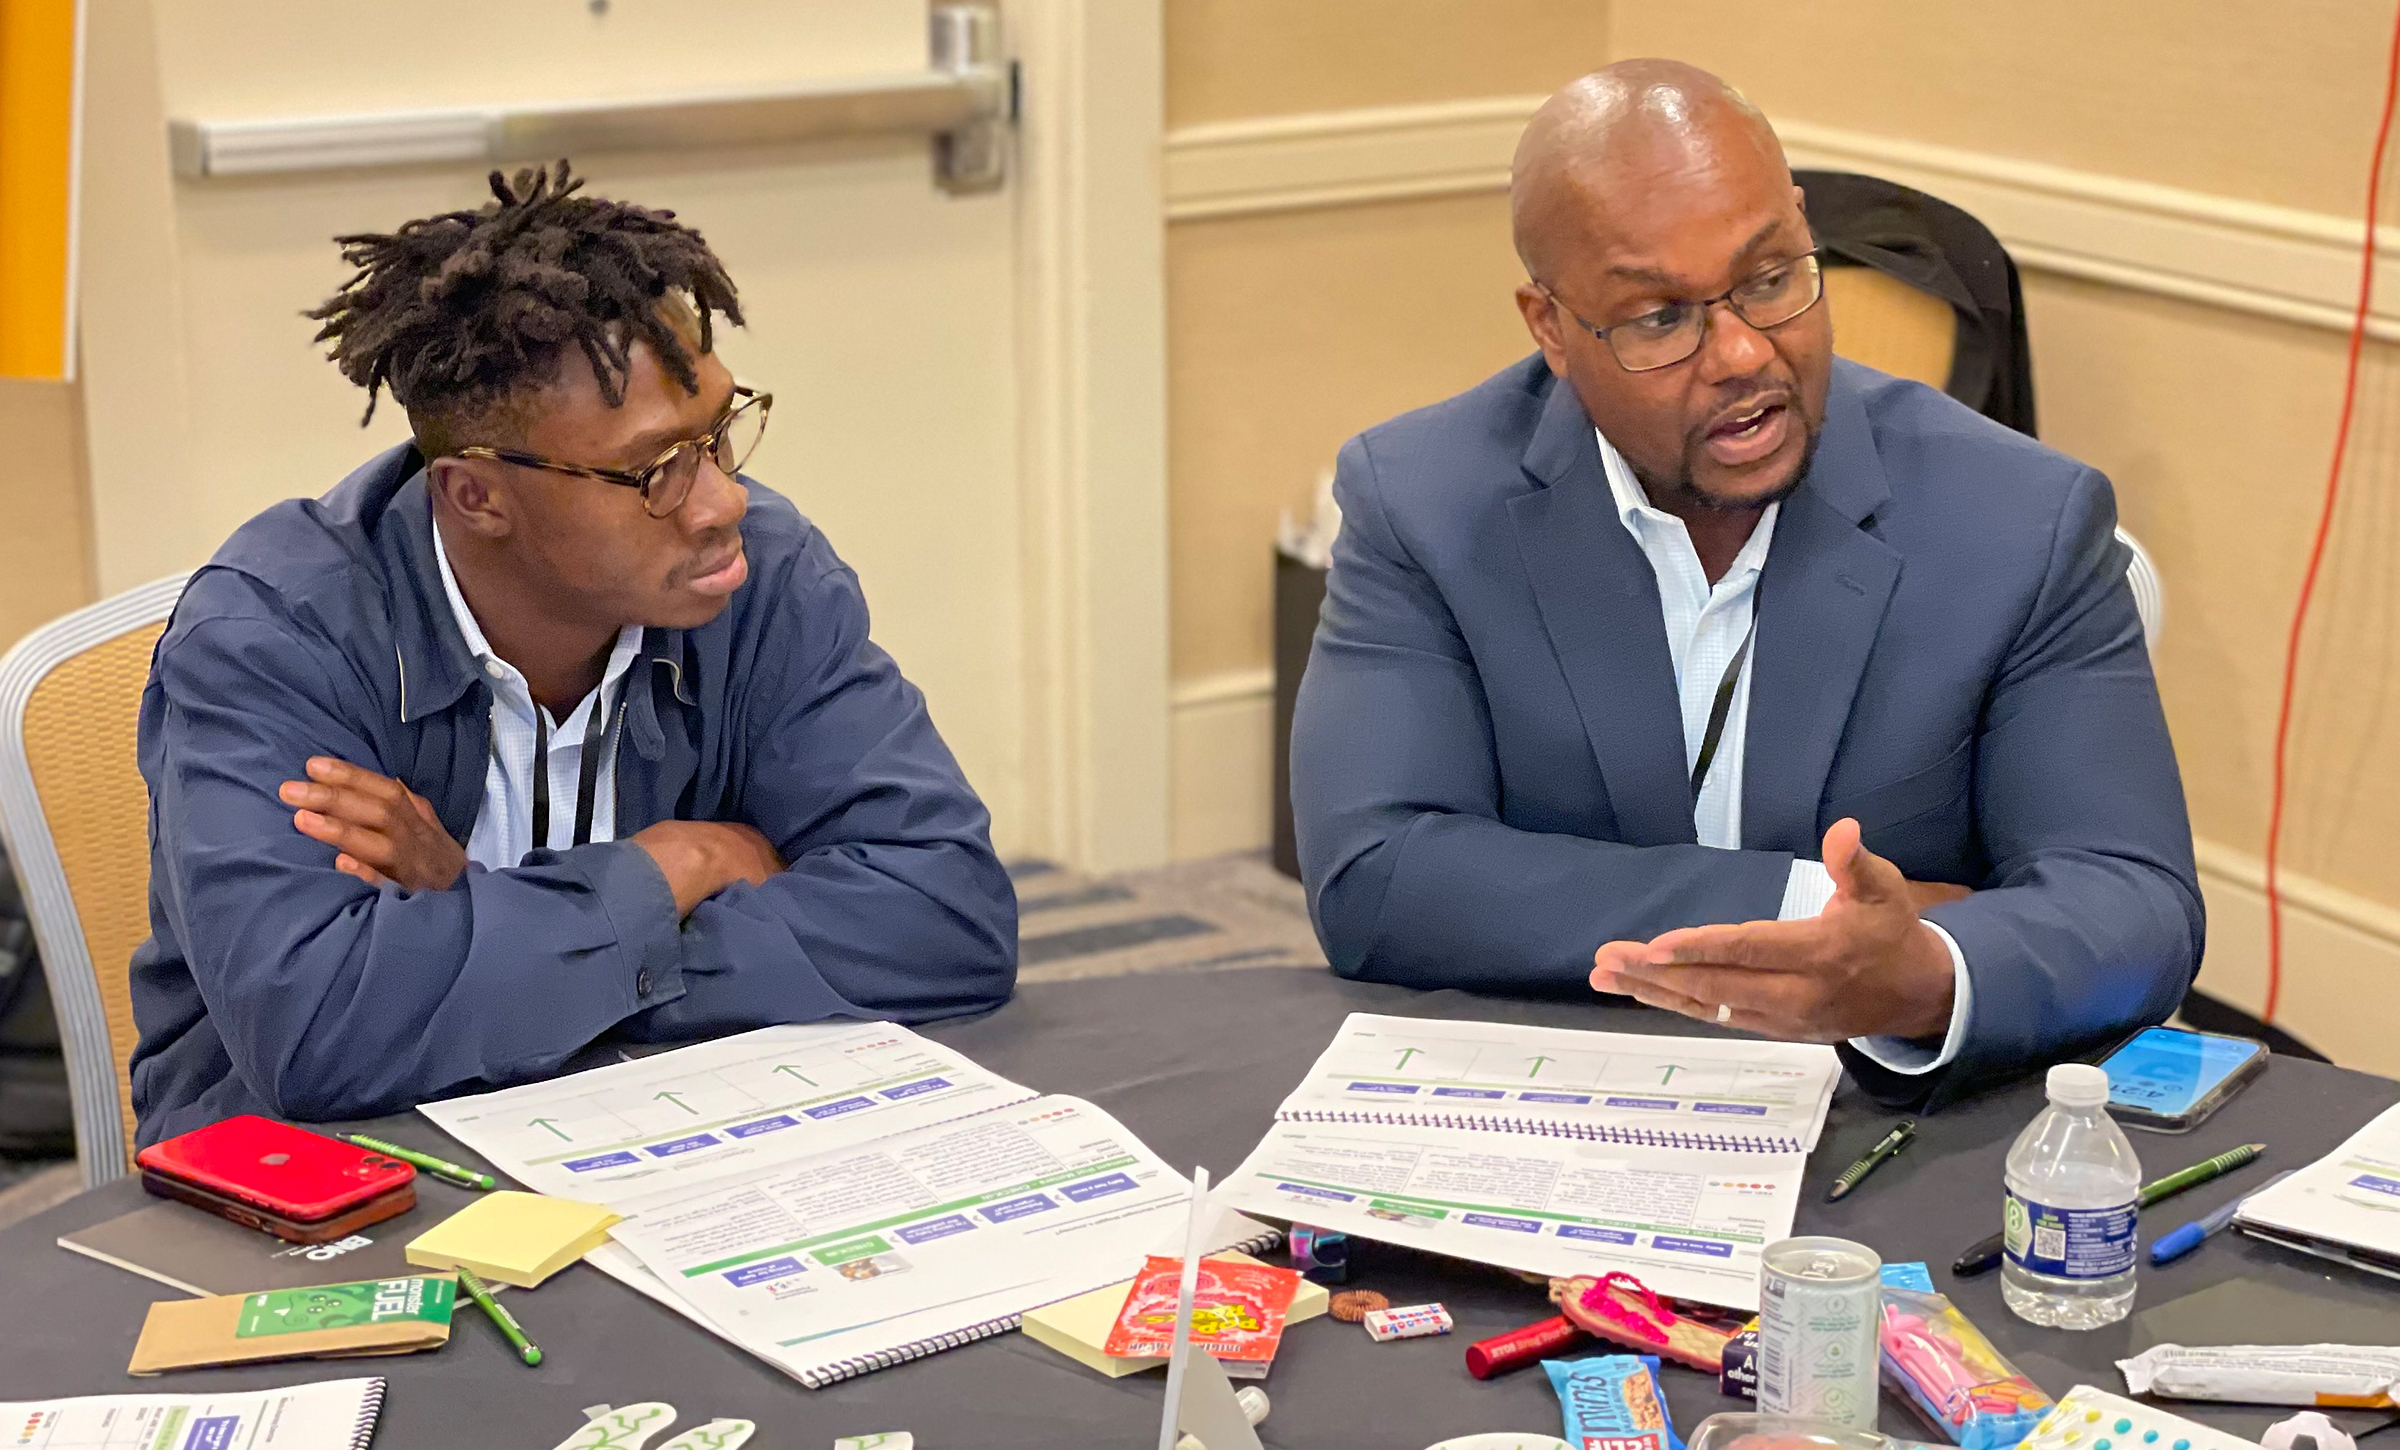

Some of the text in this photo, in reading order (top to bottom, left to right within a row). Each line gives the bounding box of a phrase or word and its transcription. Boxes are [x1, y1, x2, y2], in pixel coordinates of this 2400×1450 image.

[371, 1279, 409, 1322] FUEL
[405, 1278, 424, 1316] monster
[1198, 1319, 1260, 1335] POP
[1727, 1366, 1756, 1383] other
[1568, 1372, 1621, 1433] minis
